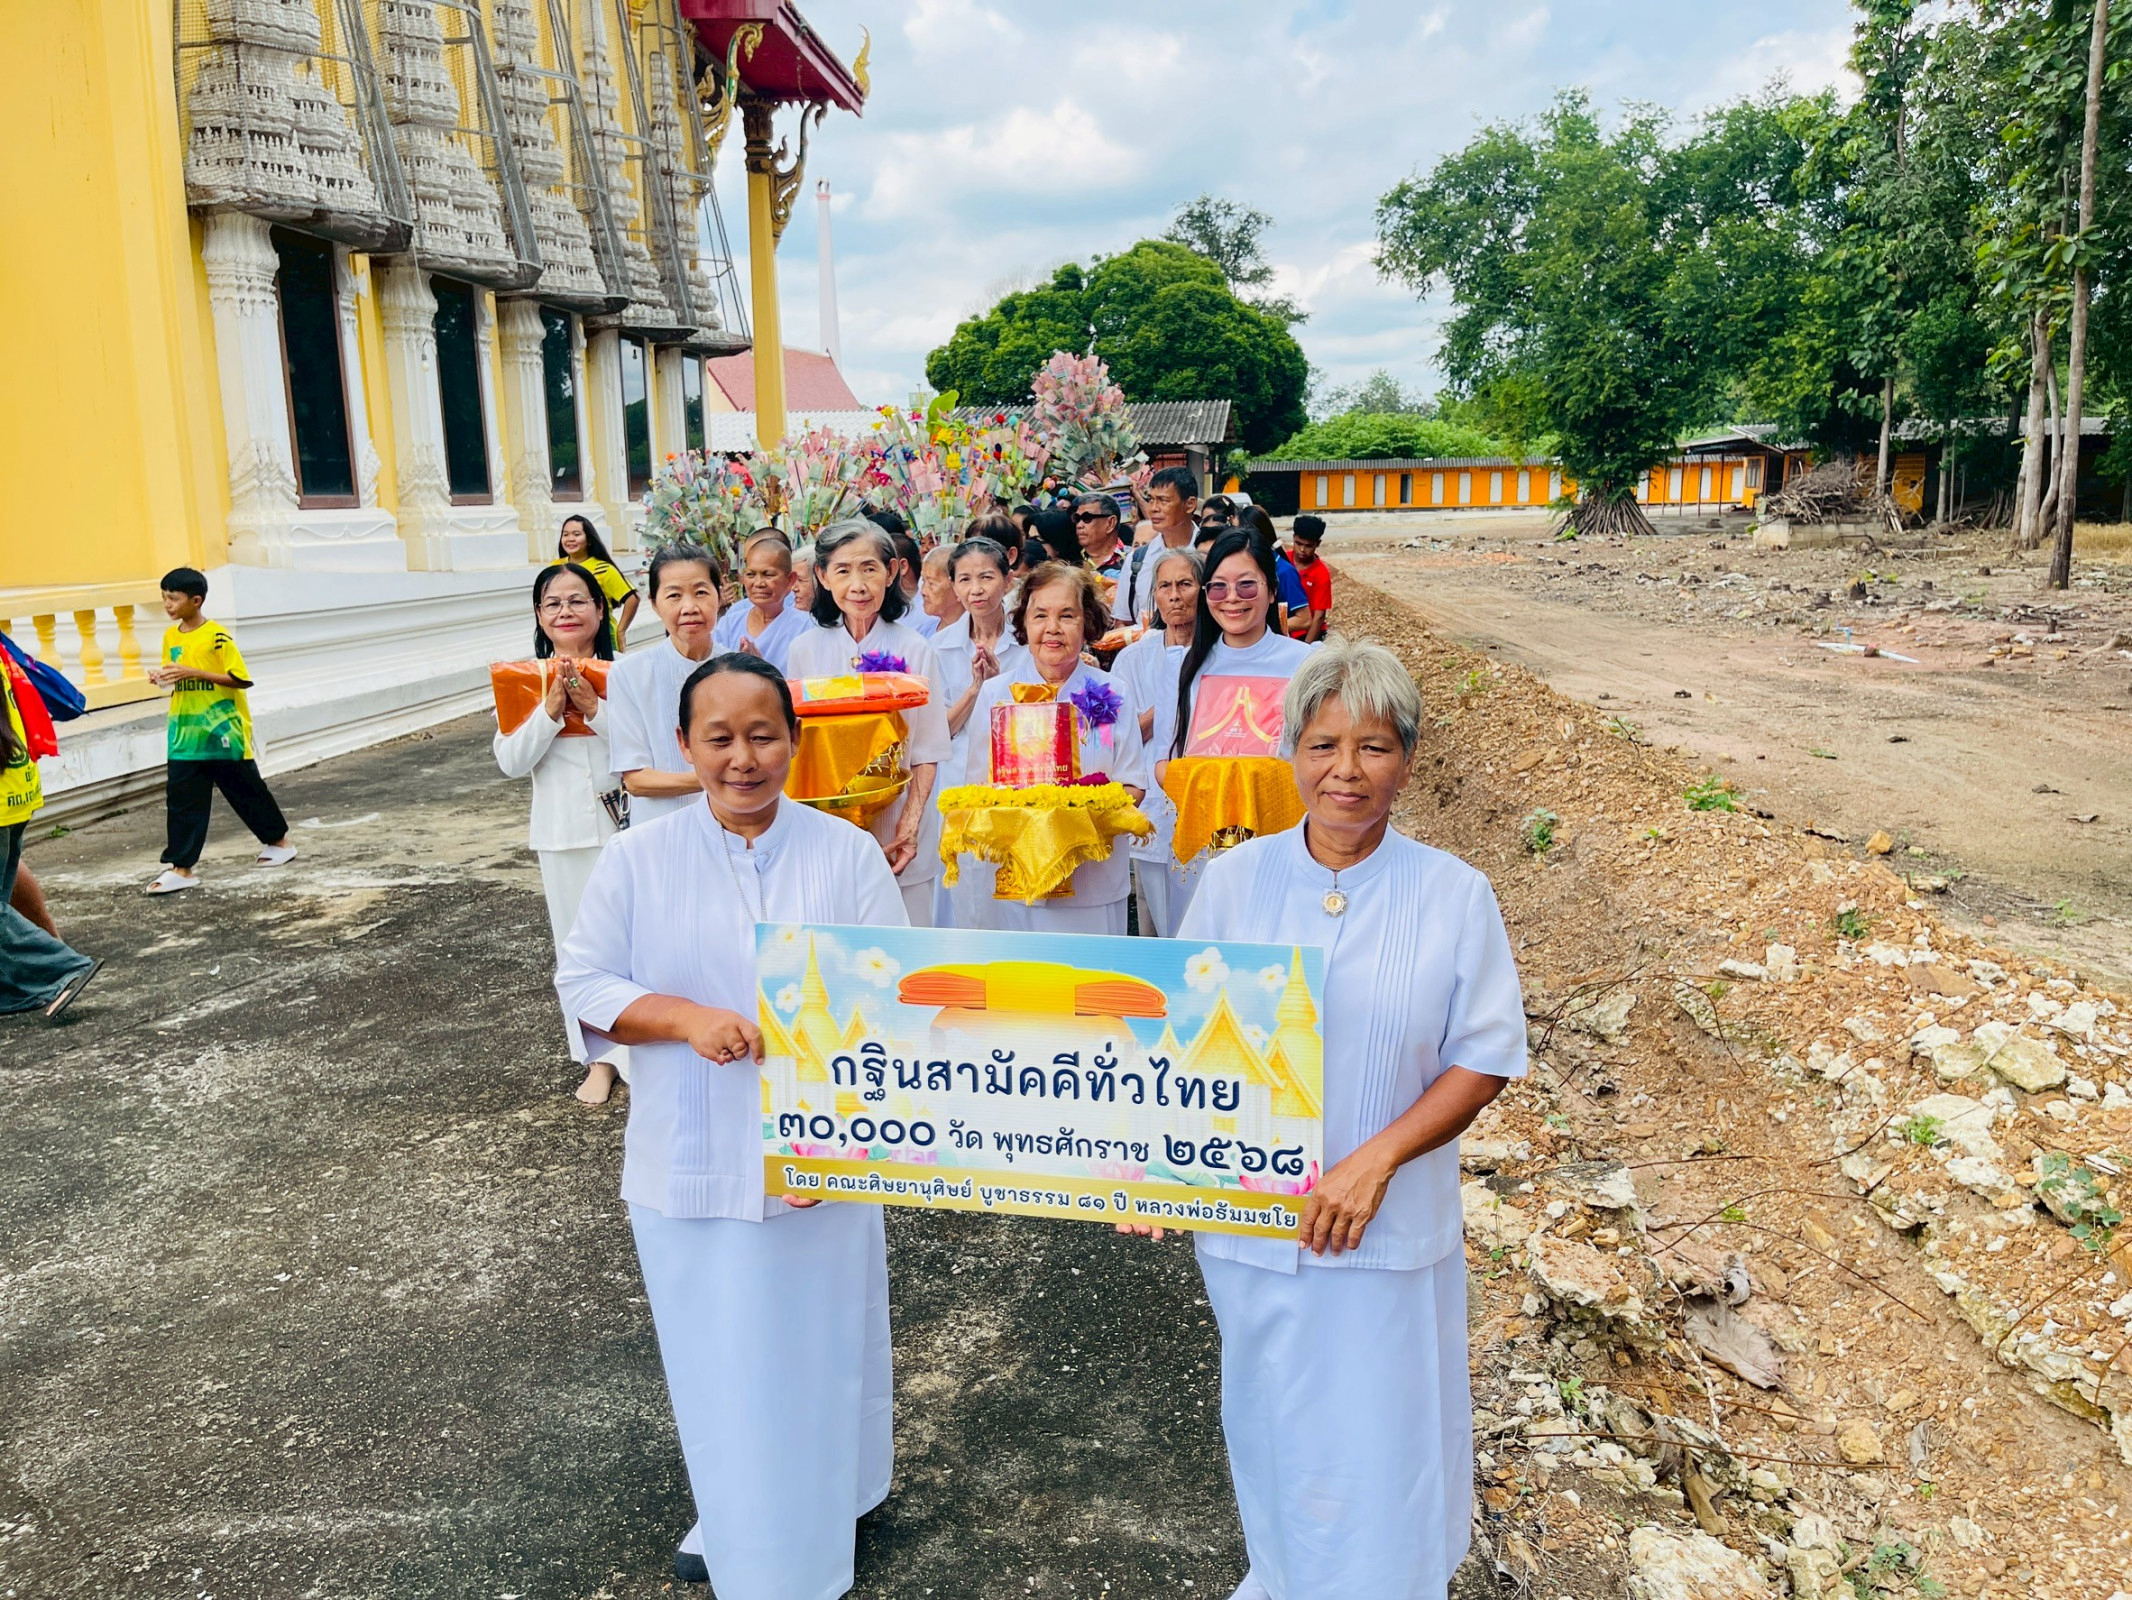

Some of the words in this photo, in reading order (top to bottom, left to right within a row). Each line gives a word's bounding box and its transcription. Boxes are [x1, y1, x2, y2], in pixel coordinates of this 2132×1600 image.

[831, 1041, 1240, 1112] กฐินสามัคคีทั่วไทย
[779, 1112, 936, 1147] ๓๐,๐๐๐
[948, 1118, 983, 1149] วัด
[993, 1126, 1149, 1163] พุทธศักราช
[1163, 1134, 1304, 1176] ๒๕๖๘
[785, 1167, 819, 1187] โดย
[827, 1173, 972, 1201] คณะศิษยานุศิษย์
[980, 1185, 1070, 1206] บูชาธรรม
[1078, 1194, 1106, 1210] ๘๑
[1114, 1190, 1127, 1211] ปี
[1135, 1198, 1298, 1228] หลวงพ่อธัมมชโย
